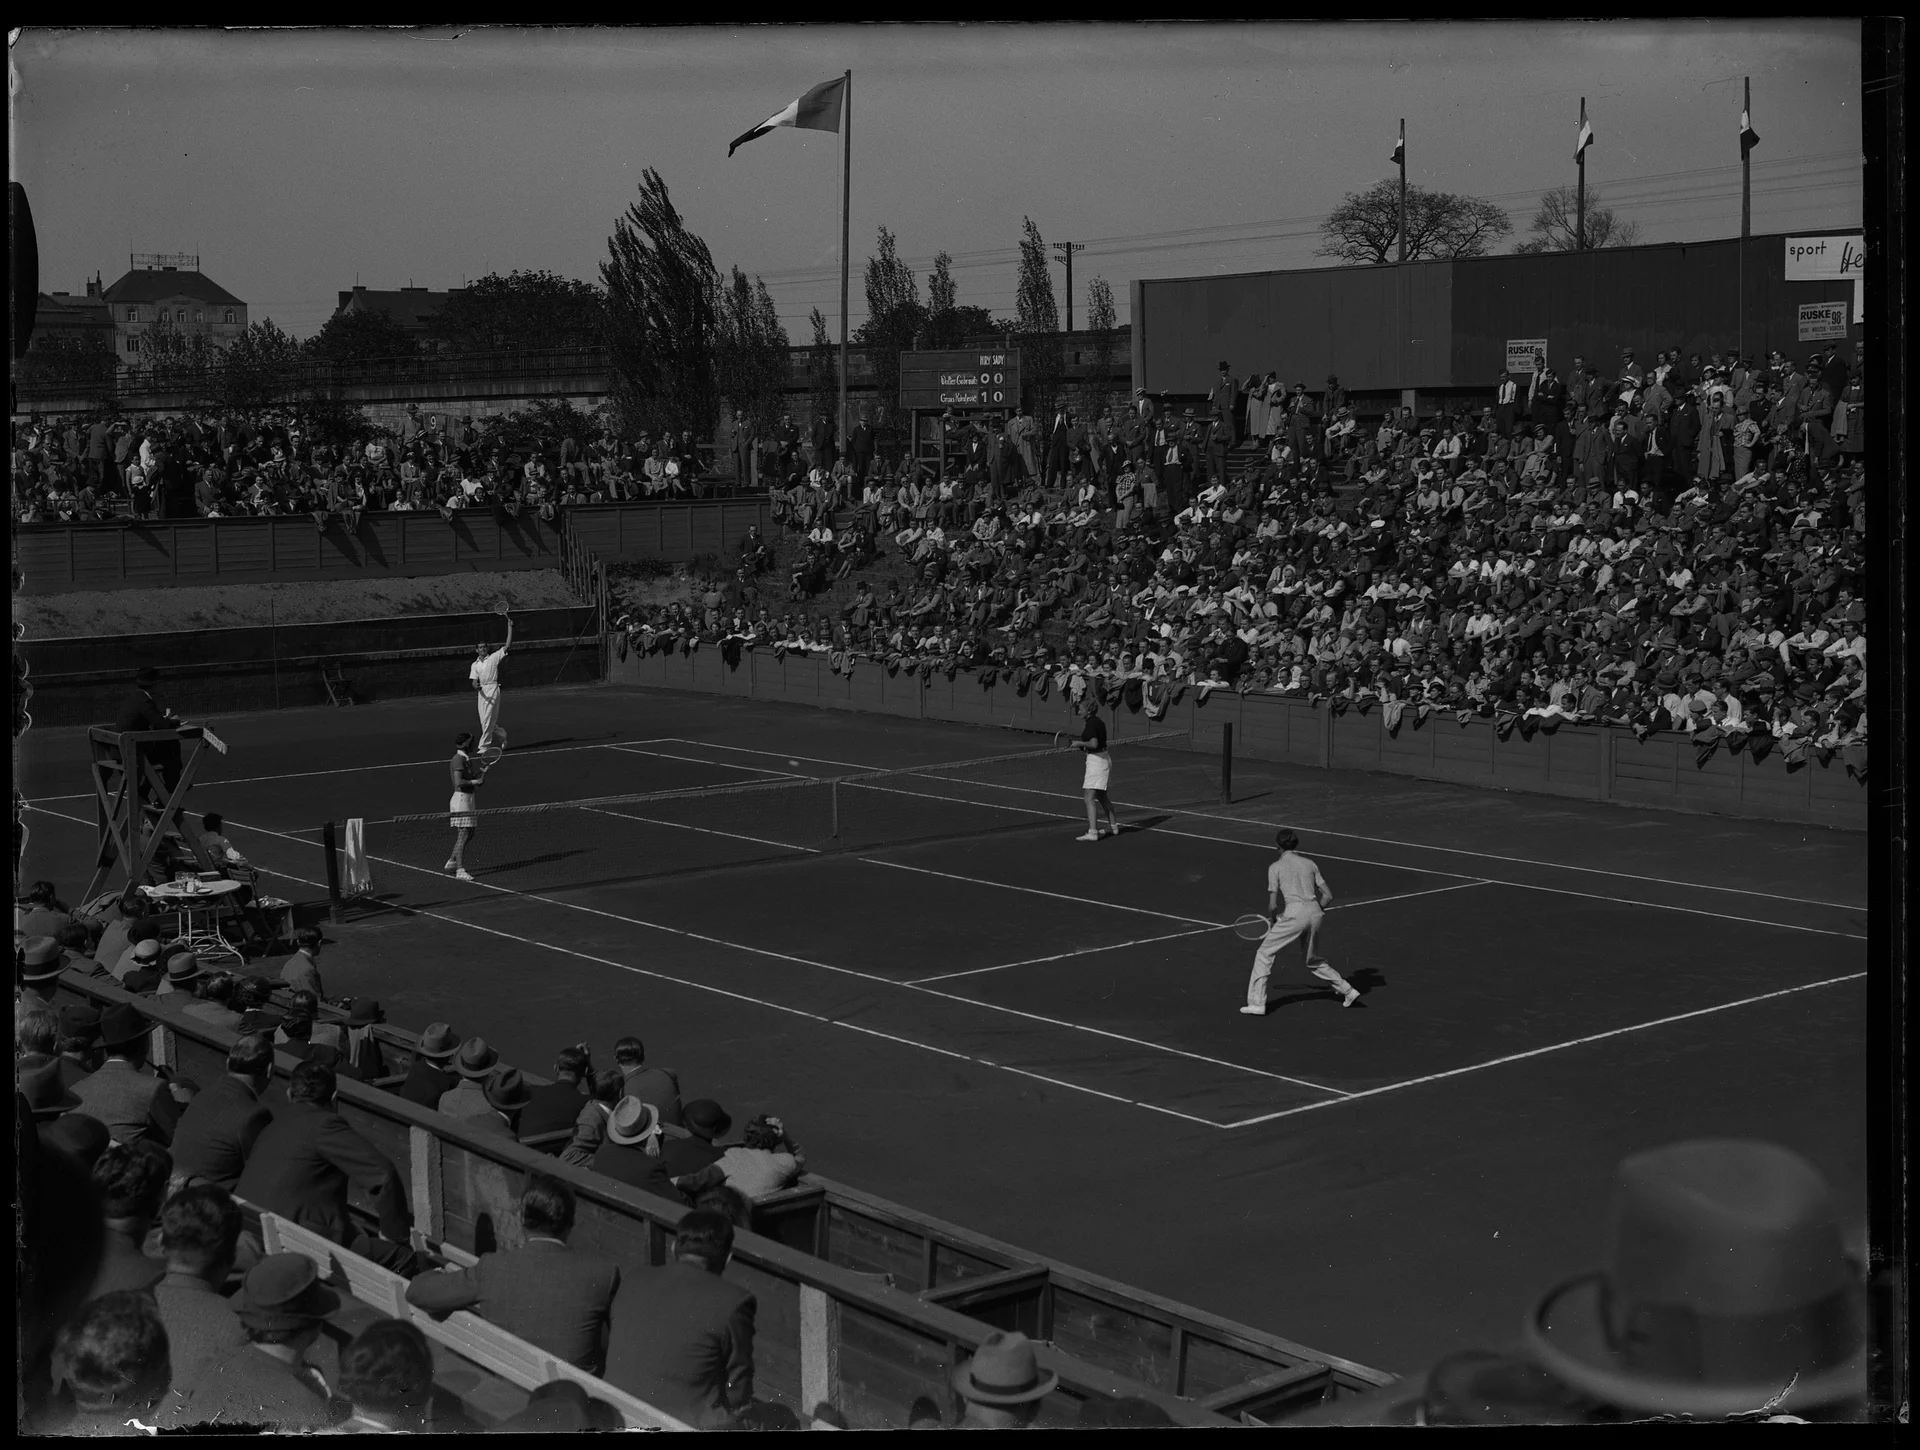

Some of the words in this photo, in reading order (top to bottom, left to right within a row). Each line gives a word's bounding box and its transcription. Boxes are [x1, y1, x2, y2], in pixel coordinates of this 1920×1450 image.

[1789, 240, 1827, 262] sport
[1800, 309, 1831, 321] RUSKE
[1508, 346, 1534, 354] RUSKE
[980, 373, 990, 384] 0
[993, 372, 1003, 384] 0
[981, 391, 988, 403] 1
[993, 391, 1003, 403] 0
[430, 415, 437, 430] 9
